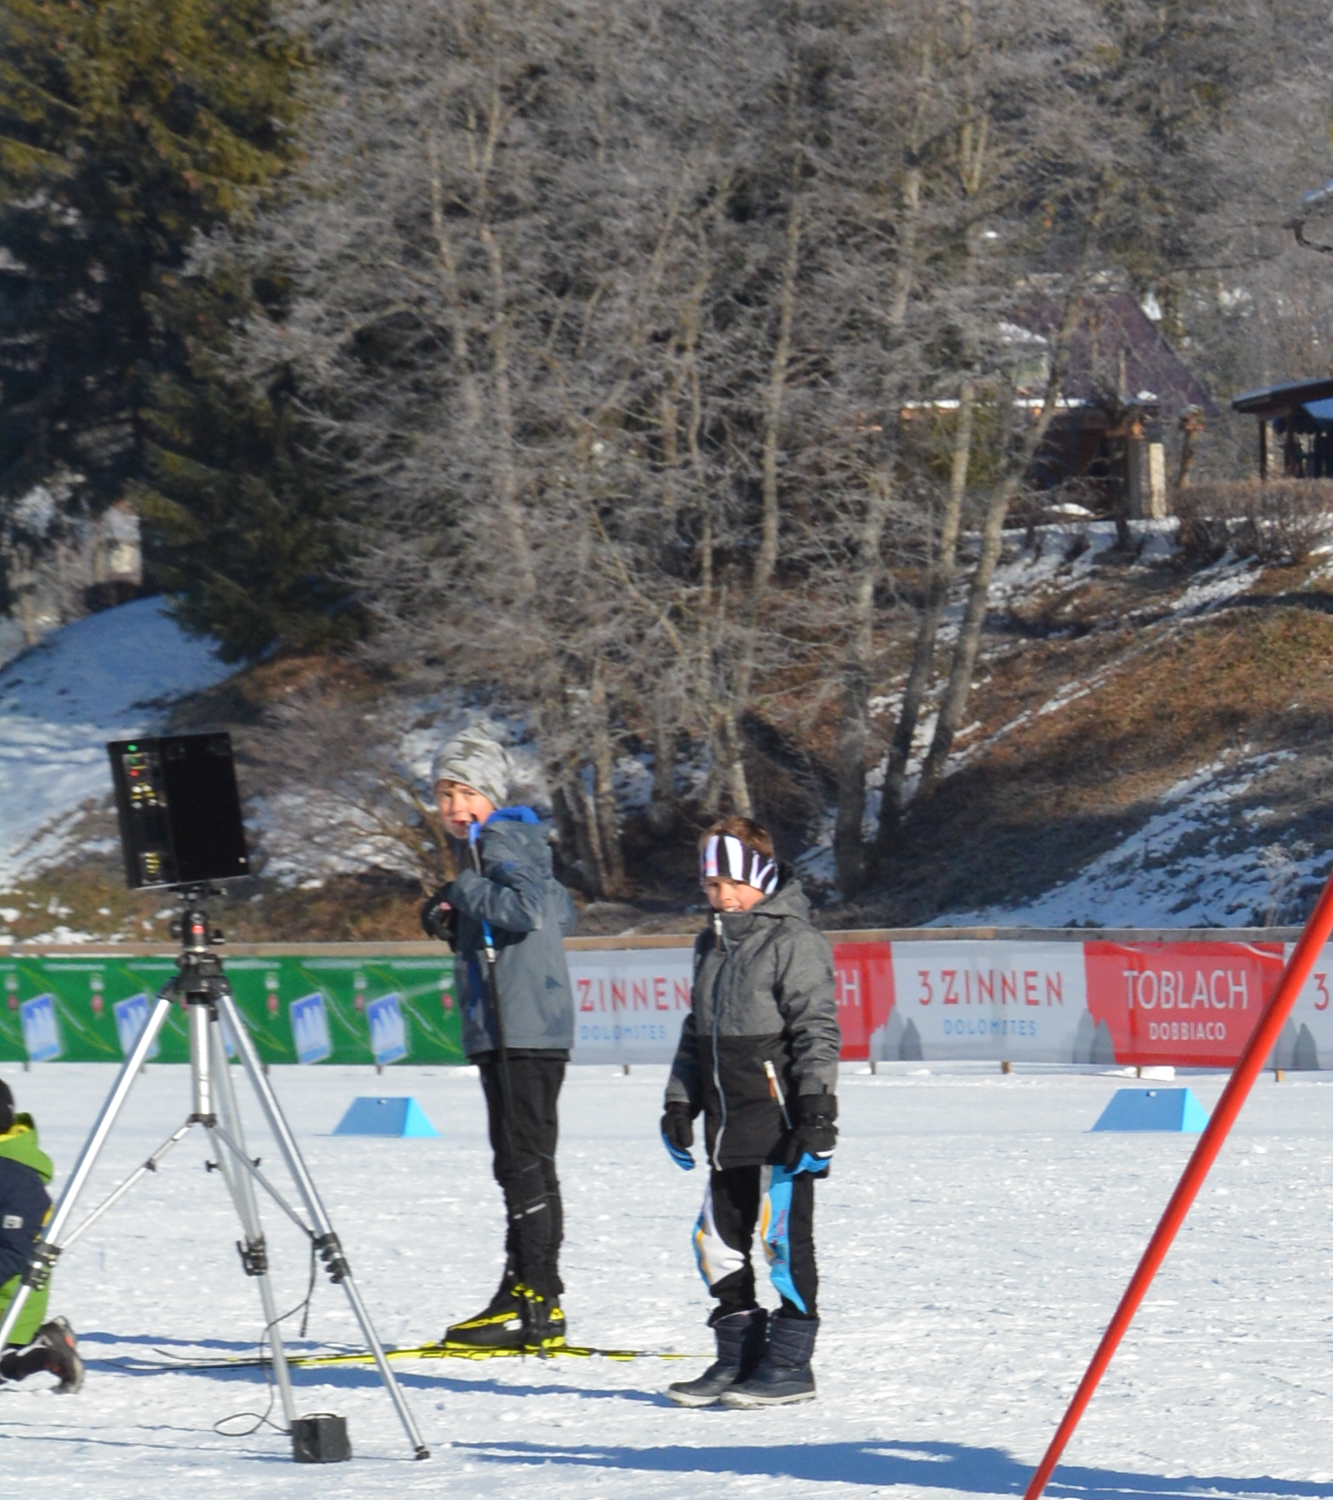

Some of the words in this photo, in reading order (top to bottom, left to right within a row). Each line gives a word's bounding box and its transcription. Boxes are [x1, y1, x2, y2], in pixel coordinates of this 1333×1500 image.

[1122, 968, 1249, 1010] TOBLACH
[943, 1018, 1037, 1037] DOLOMITES
[1149, 1021, 1227, 1041] DOBBIACO
